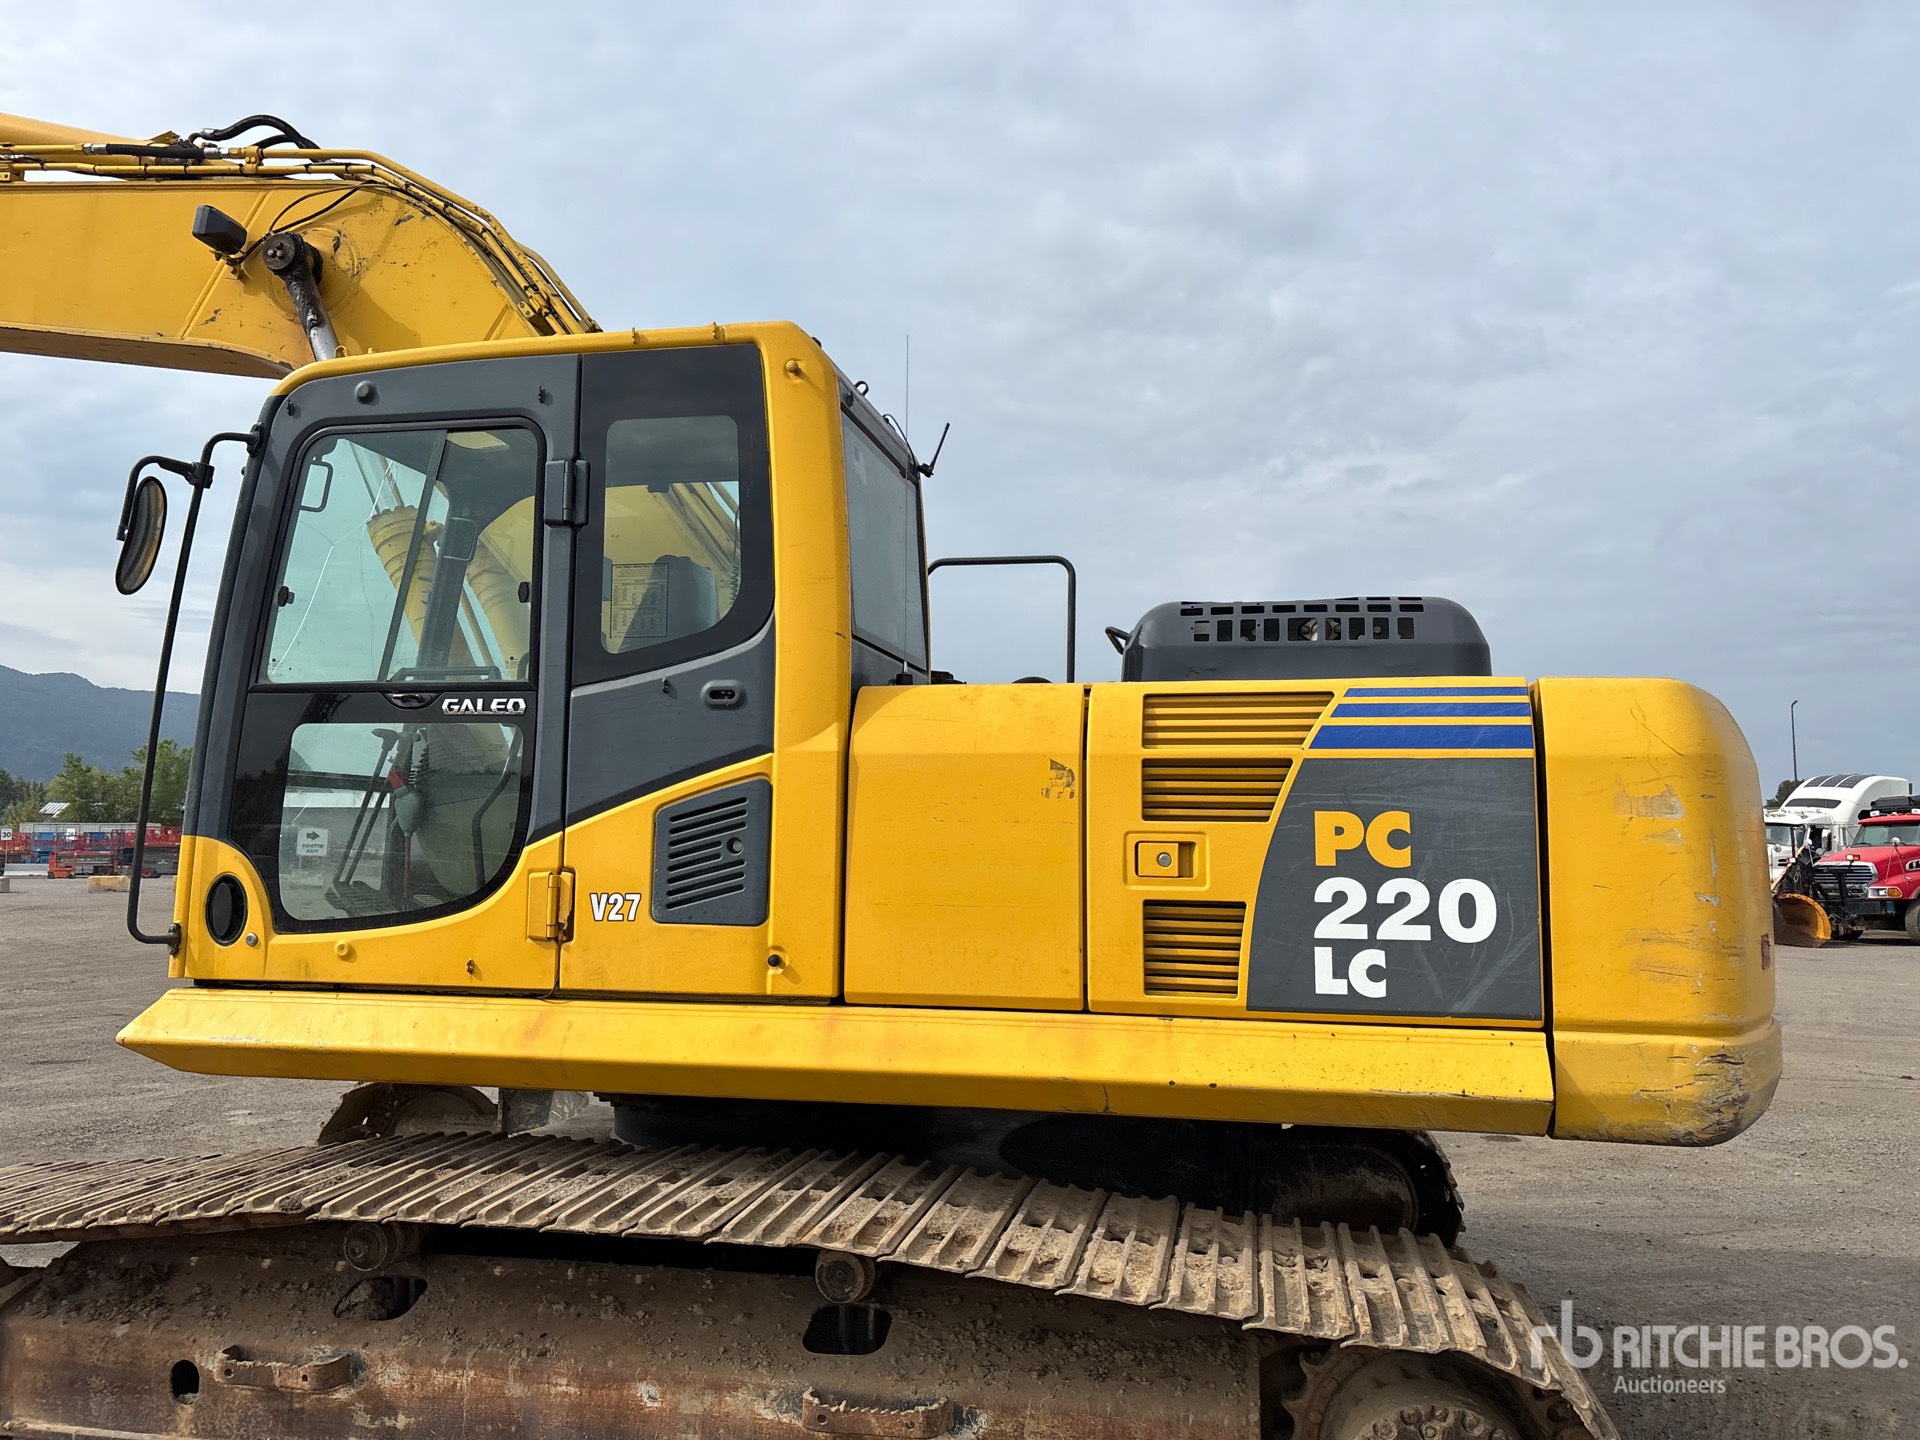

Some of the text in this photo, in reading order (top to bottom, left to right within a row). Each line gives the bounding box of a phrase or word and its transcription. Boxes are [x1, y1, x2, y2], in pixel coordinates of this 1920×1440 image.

[442, 698, 526, 715] GALEO
[1314, 810, 1412, 869] PC
[589, 892, 642, 921] V27
[1313, 876, 1497, 944] 220
[1314, 946, 1387, 999] LC
